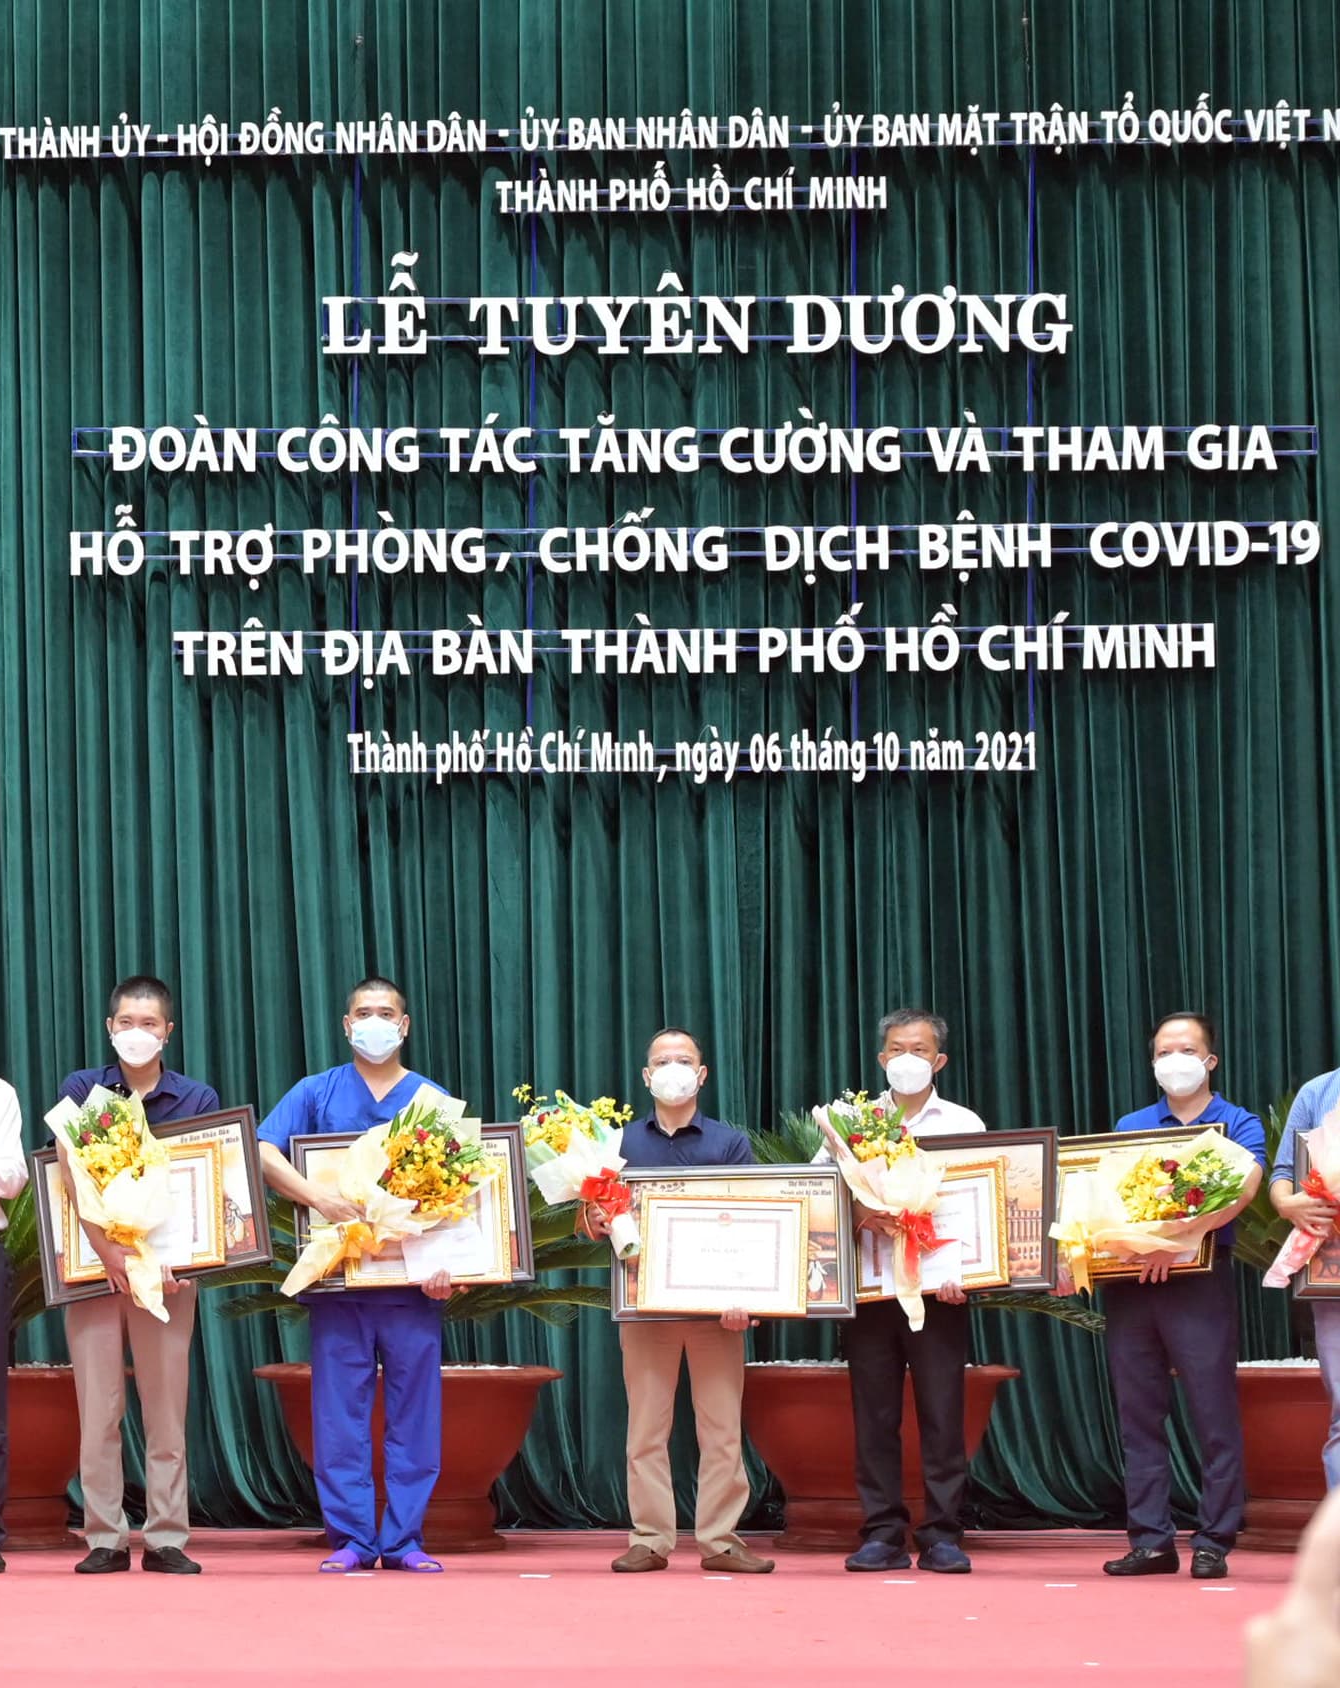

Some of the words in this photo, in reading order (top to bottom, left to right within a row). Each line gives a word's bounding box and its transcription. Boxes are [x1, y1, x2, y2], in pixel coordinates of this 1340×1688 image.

[0, 117, 99, 159] THÀNH
[112, 113, 150, 157] ỦY
[157, 134, 168, 142] -
[177, 114, 228, 166] HỘI
[238, 107, 324, 155] ĐỒNG
[336, 112, 417, 153] NHÂN
[427, 112, 486, 152] DÂN
[521, 107, 559, 151] ỦY
[568, 117, 629, 150] BAN
[637, 109, 718, 149] NHÂN
[729, 107, 789, 148] DÂN
[801, 125, 812, 133] -
[824, 102, 864, 147] ỦY
[873, 114, 930, 146] BAN
[938, 105, 999, 155] MẶT
[1010, 103, 1088, 153] TRẬN
[1101, 91, 1139, 143] TỔ
[1149, 92, 1233, 146] QUỐC
[1245, 100, 1310, 148] VIỆT
[496, 169, 598, 213] THÀNH
[610, 161, 670, 212] PHỐ
[687, 164, 730, 211] HỒ
[744, 167, 793, 210] CHÍ
[809, 176, 887, 209] MINH
[322, 252, 427, 354] LỄ
[469, 273, 756, 355] TUYÊN
[786, 285, 1073, 354] DƯƠNG
[109, 415, 257, 472] ĐOÀN
[277, 414, 419, 473] CÔNG
[439, 413, 536, 473] TÁC
[559, 414, 700, 473] TĂNG
[720, 407, 901, 473] CƯỜNG
[928, 411, 991, 473] VÀ
[1013, 426, 1164, 471] THAM
[1186, 424, 1277, 471] GIA
[70, 505, 144, 576] HỖ
[170, 523, 274, 590] TRỢ
[303, 511, 512, 575] PHÒNG,
[539, 508, 728, 573] CHỐNG
[764, 525, 889, 584] DỊCH
[918, 510, 1052, 583] BỆNH
[1089, 520, 1320, 568] COVID-19
[173, 617, 303, 676] TRÊN
[321, 630, 410, 689] ĐỊA
[432, 615, 534, 675] BÀN
[561, 613, 737, 674] THÀNH
[759, 603, 864, 673] PHỐ
[885, 604, 960, 672] HỒ
[978, 612, 1069, 671] CHÍ
[1083, 623, 1215, 669] MINH
[347, 731, 427, 773] Thành
[436, 729, 490, 784] phố
[496, 727, 533, 773] Hồ
[540, 729, 585, 773] Chí
[674, 726, 739, 784] ngày
[749, 733, 782, 772] 06
[791, 727, 866, 782] tháng
[876, 732, 899, 771] 10
[910, 728, 966, 771] năm
[974, 731, 1036, 771] 2021
